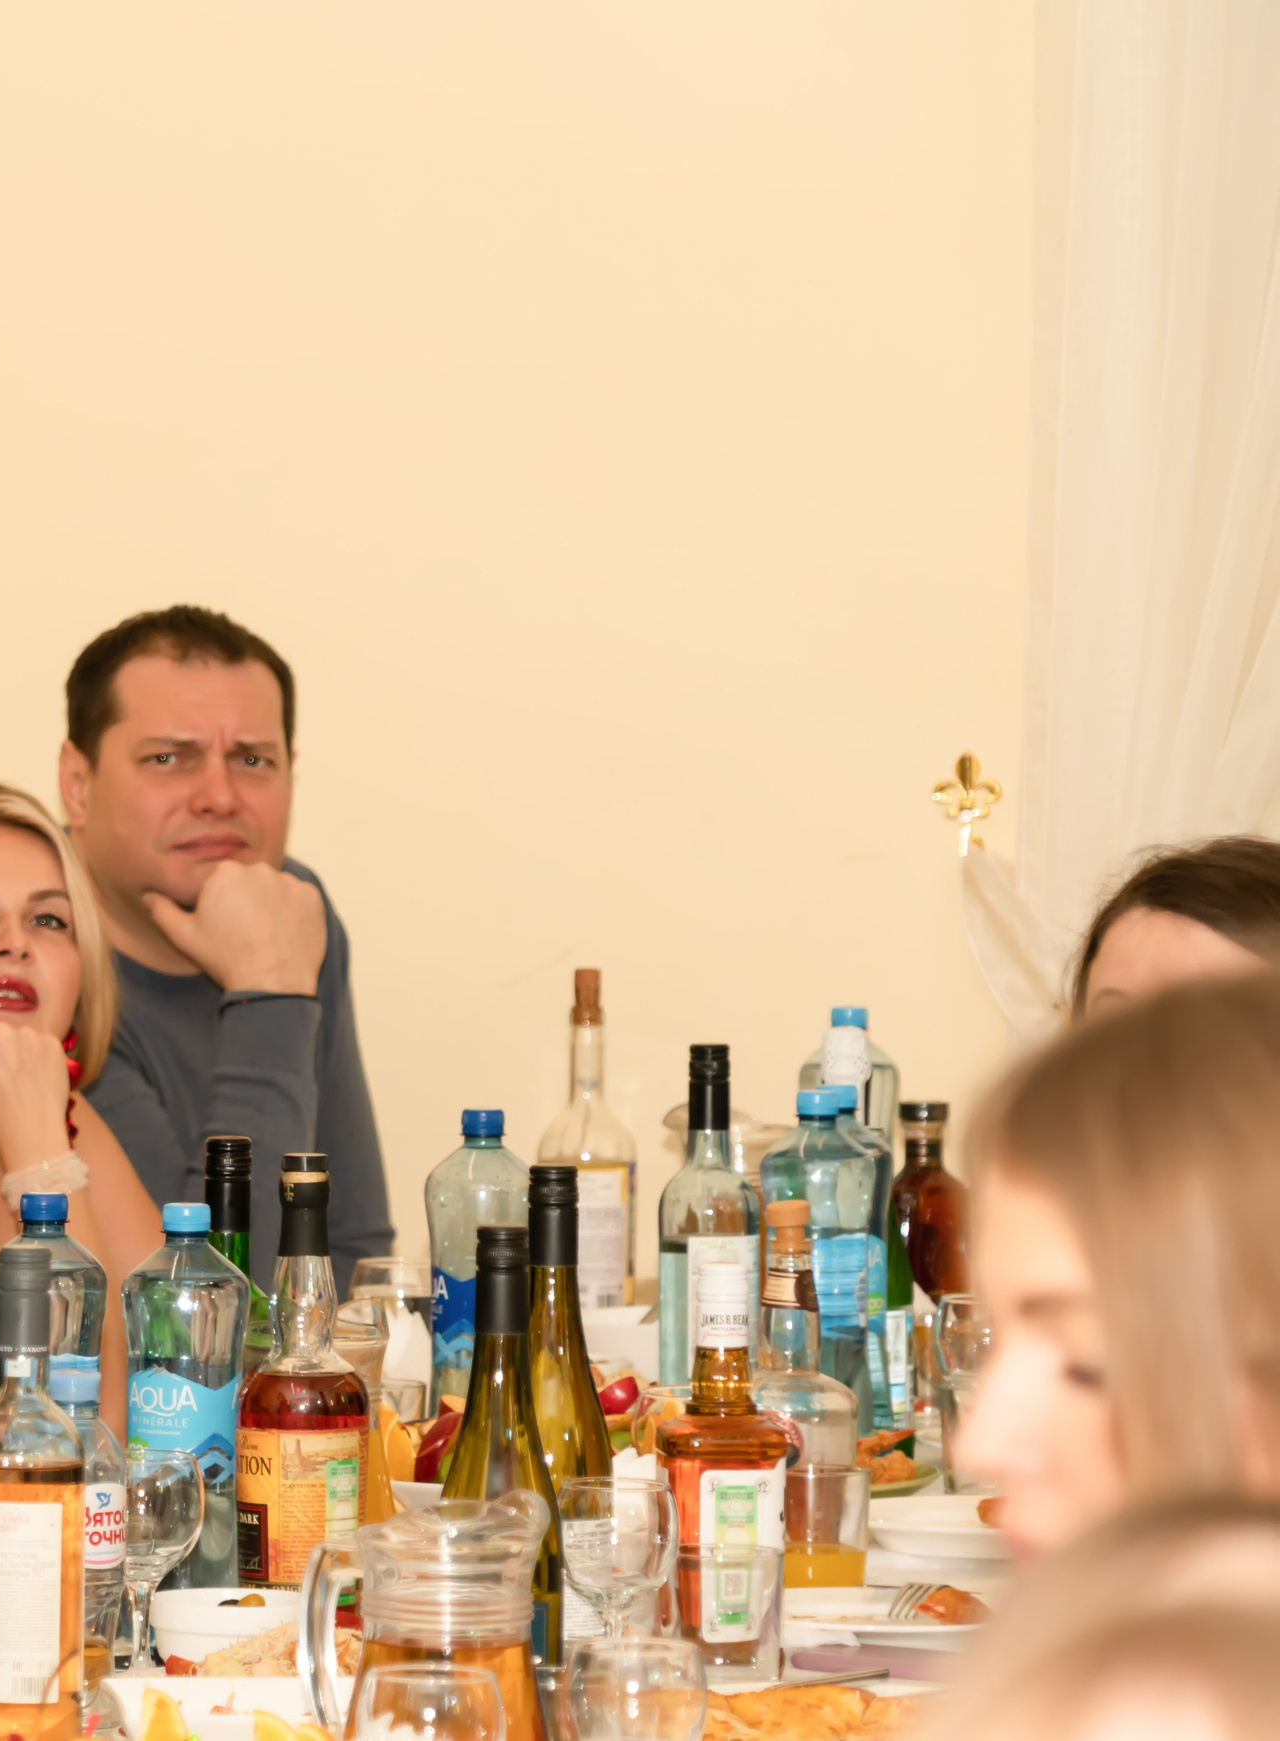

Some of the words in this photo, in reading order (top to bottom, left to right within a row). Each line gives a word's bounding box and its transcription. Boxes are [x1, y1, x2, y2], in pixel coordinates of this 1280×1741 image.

[701, 1314, 725, 1327] JAMES
[129, 1382, 198, 1417] AQUA
[132, 1415, 190, 1428] MINERALE
[239, 1512, 260, 1526] DARK
